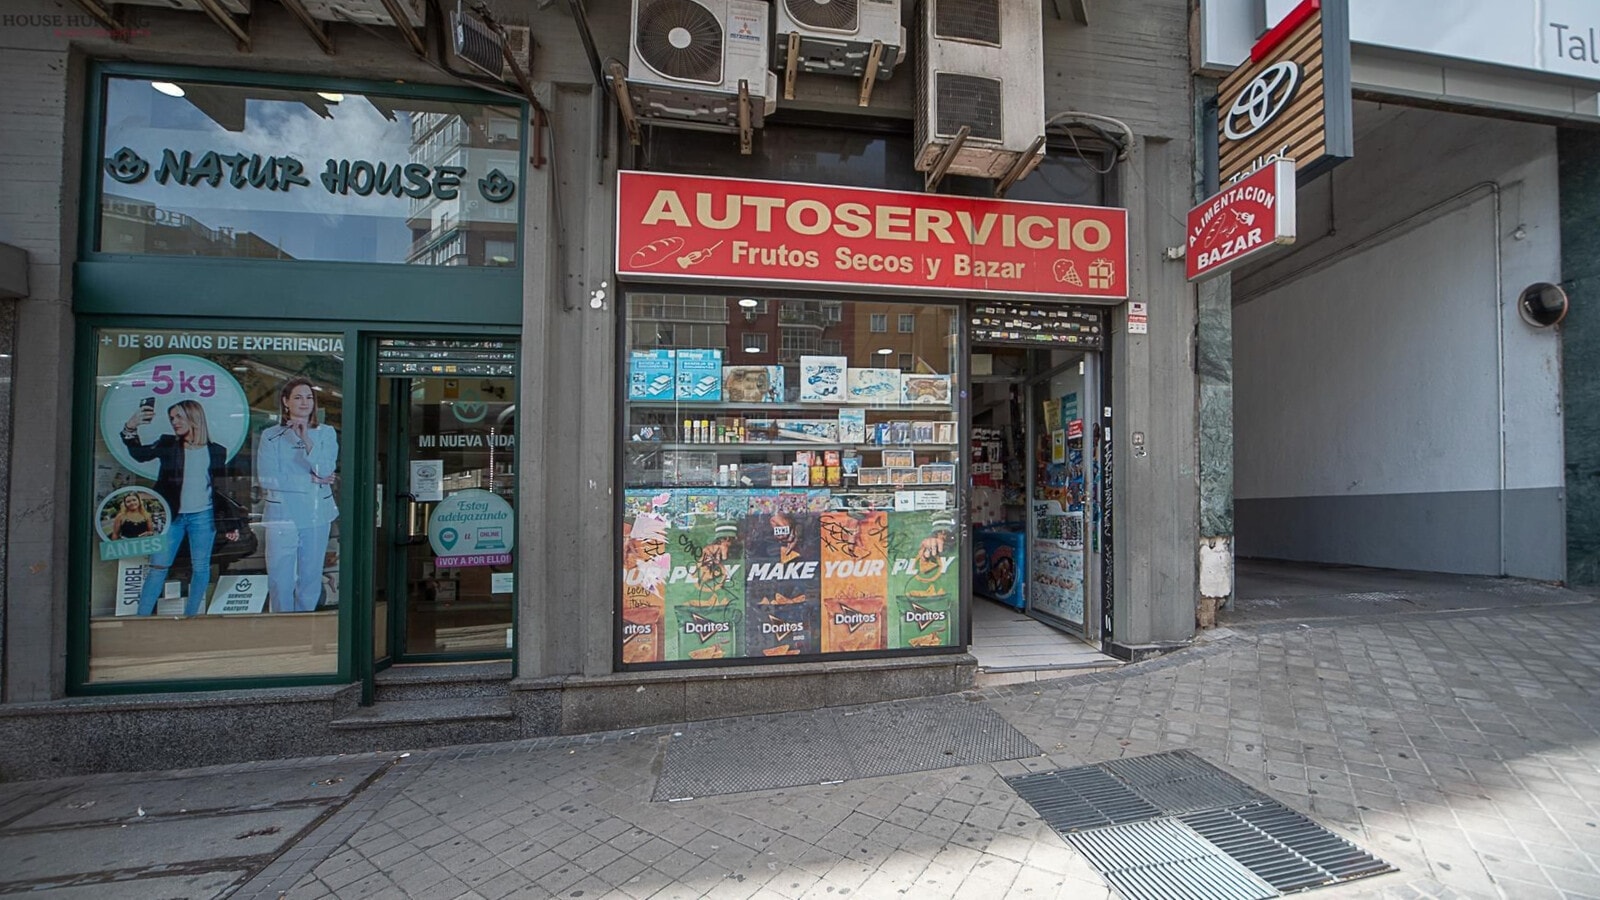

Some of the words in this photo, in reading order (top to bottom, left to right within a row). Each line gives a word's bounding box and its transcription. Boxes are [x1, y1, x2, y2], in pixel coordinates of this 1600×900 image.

[1549, 22, 1600, 64] Tal
[155, 148, 310, 192] NATUR
[320, 158, 467, 200] HOUSE
[641, 189, 1112, 251] AUTOSERVICIO
[1189, 186, 1275, 248] ALIMENTACION
[1197, 228, 1262, 270] BAZAR
[732, 241, 819, 267] Frutos
[835, 246, 913, 273] Secos
[926, 258, 940, 280] y
[954, 254, 1025, 280] Bazar
[118, 334, 139, 348] DE
[143, 335, 164, 349] 30
[168, 332, 212, 350] AÑOS
[217, 336, 238, 350] DE
[243, 336, 344, 351] EXPERIENCIA
[419, 435, 435, 447] MI
[439, 435, 482, 447] NUEVA
[486, 435, 515, 447] VIDA
[457, 500, 489, 512] Estoy
[437, 511, 508, 524] adelgazando
[105, 537, 163, 558] ANTES
[468, 556, 485, 564] POR
[486, 555, 509, 564] ELLO!
[747, 561, 818, 581] MAKE
[824, 559, 885, 579] YOUR
[835, 612, 876, 624] Doritos
[906, 611, 945, 622] Doritos
[624, 624, 651, 634] ritos
[685, 621, 729, 633] Doritos
[762, 621, 803, 633] Doritos
